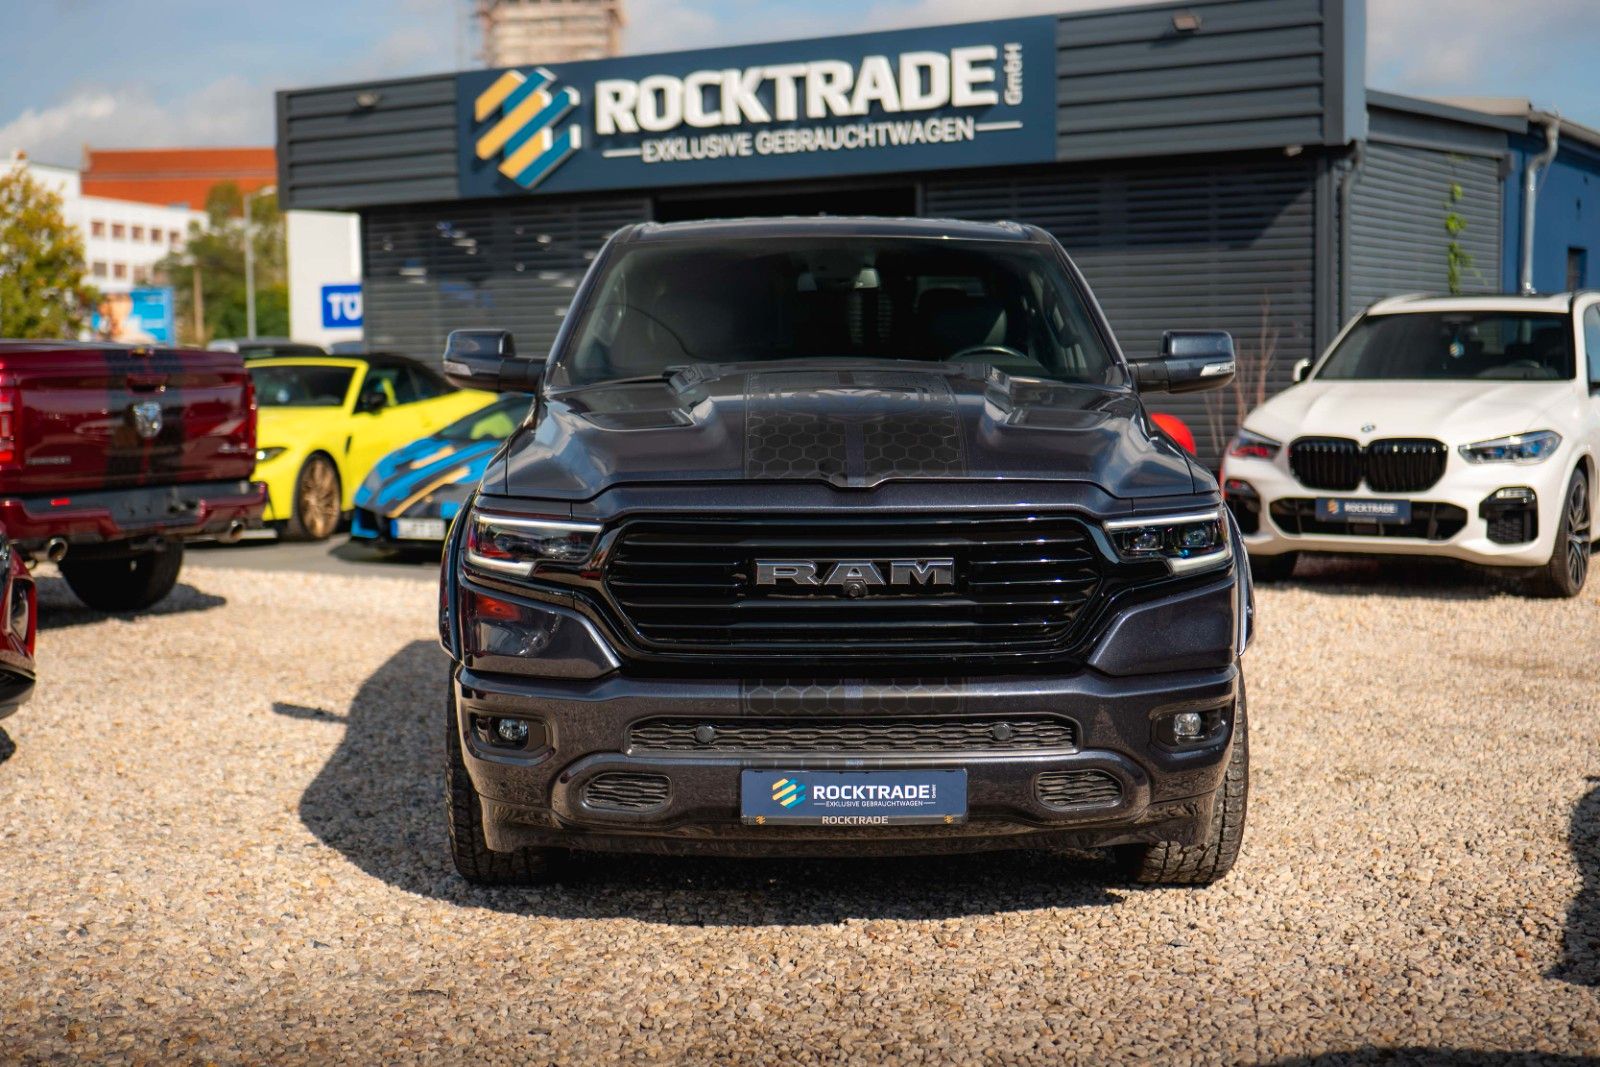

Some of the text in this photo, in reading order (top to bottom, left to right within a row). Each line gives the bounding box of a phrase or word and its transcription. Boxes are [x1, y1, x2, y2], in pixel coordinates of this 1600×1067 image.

[1003, 43, 1022, 106] GmbH
[594, 45, 999, 135] ROCKTRADE
[641, 117, 975, 163] EXKLUSIVE GEBRAUCHTWAGEN
[755, 558, 954, 586] RAM
[813, 785, 930, 800] ROCKTRADE
[825, 800, 924, 808] EXKLUSIVE GEBRAUCHTWAGEN
[822, 815, 889, 825] ROCKTRADE
